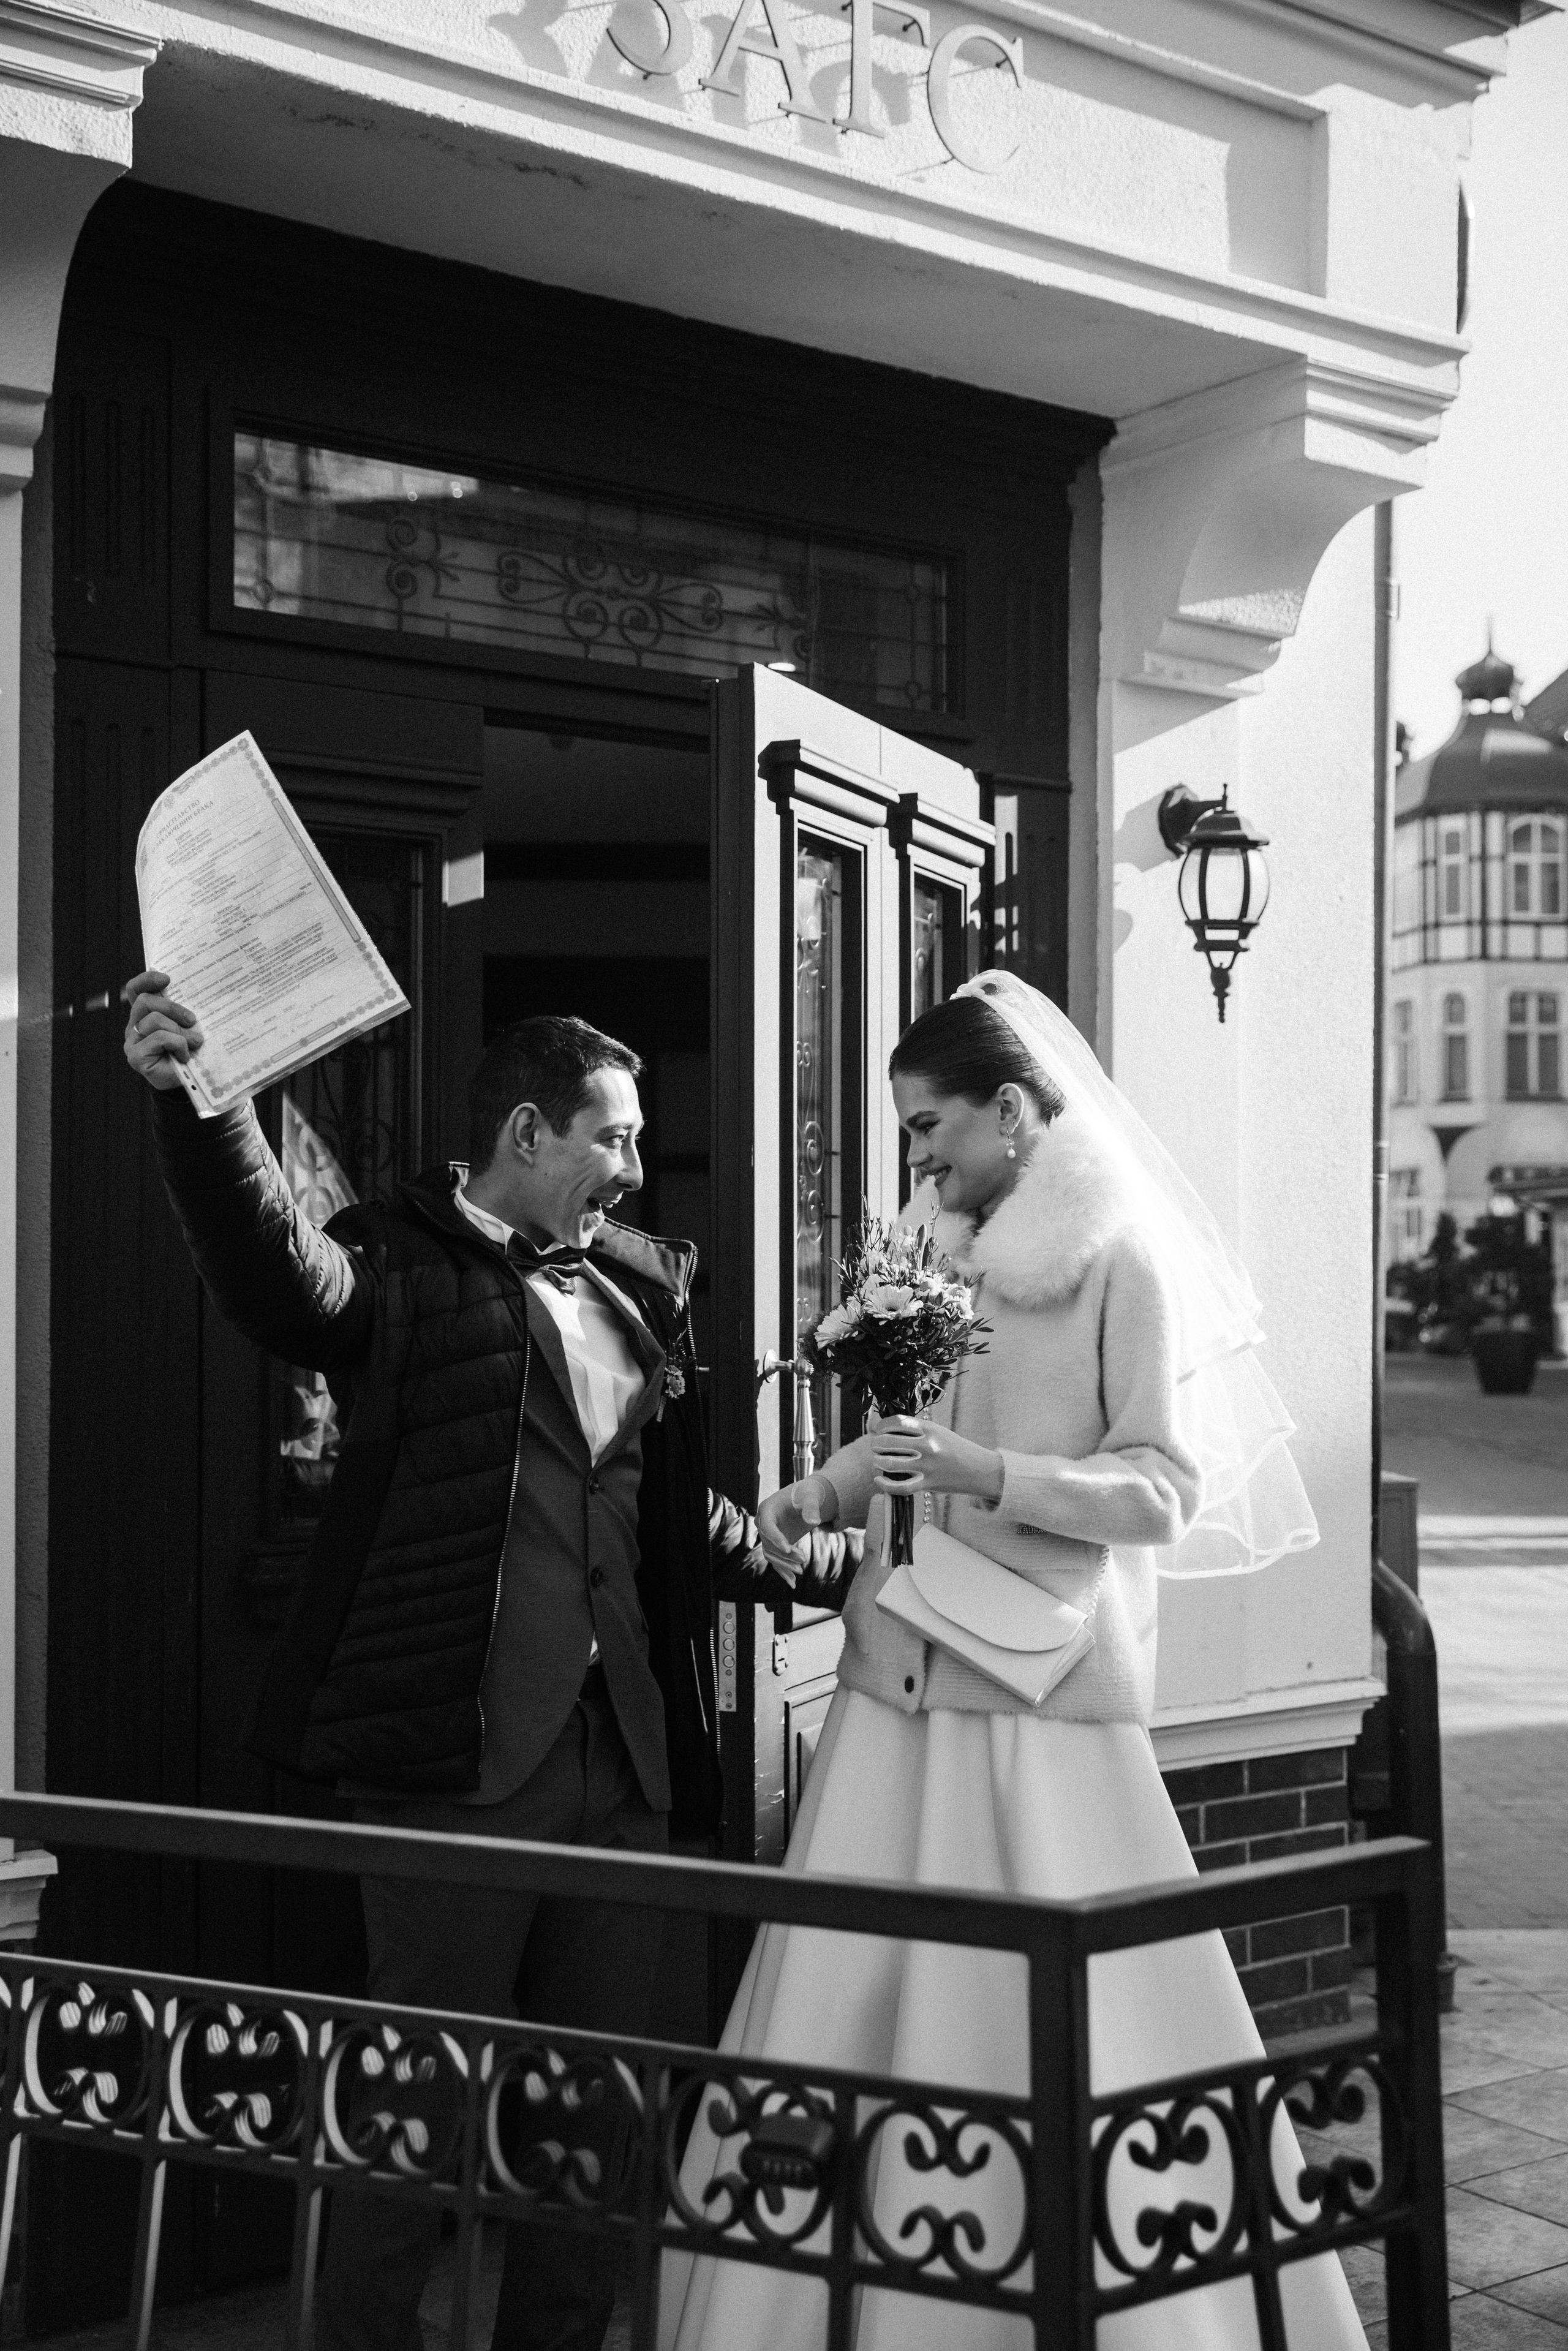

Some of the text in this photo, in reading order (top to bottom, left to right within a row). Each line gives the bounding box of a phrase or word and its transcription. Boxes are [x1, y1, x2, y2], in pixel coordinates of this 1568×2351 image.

[153, 813, 194, 849] ЗАКЛЮЧЕНИИ
[192, 799, 214, 817] БРАКА
[154, 799, 201, 839] СВИДЕТЕЛЬСТВО
